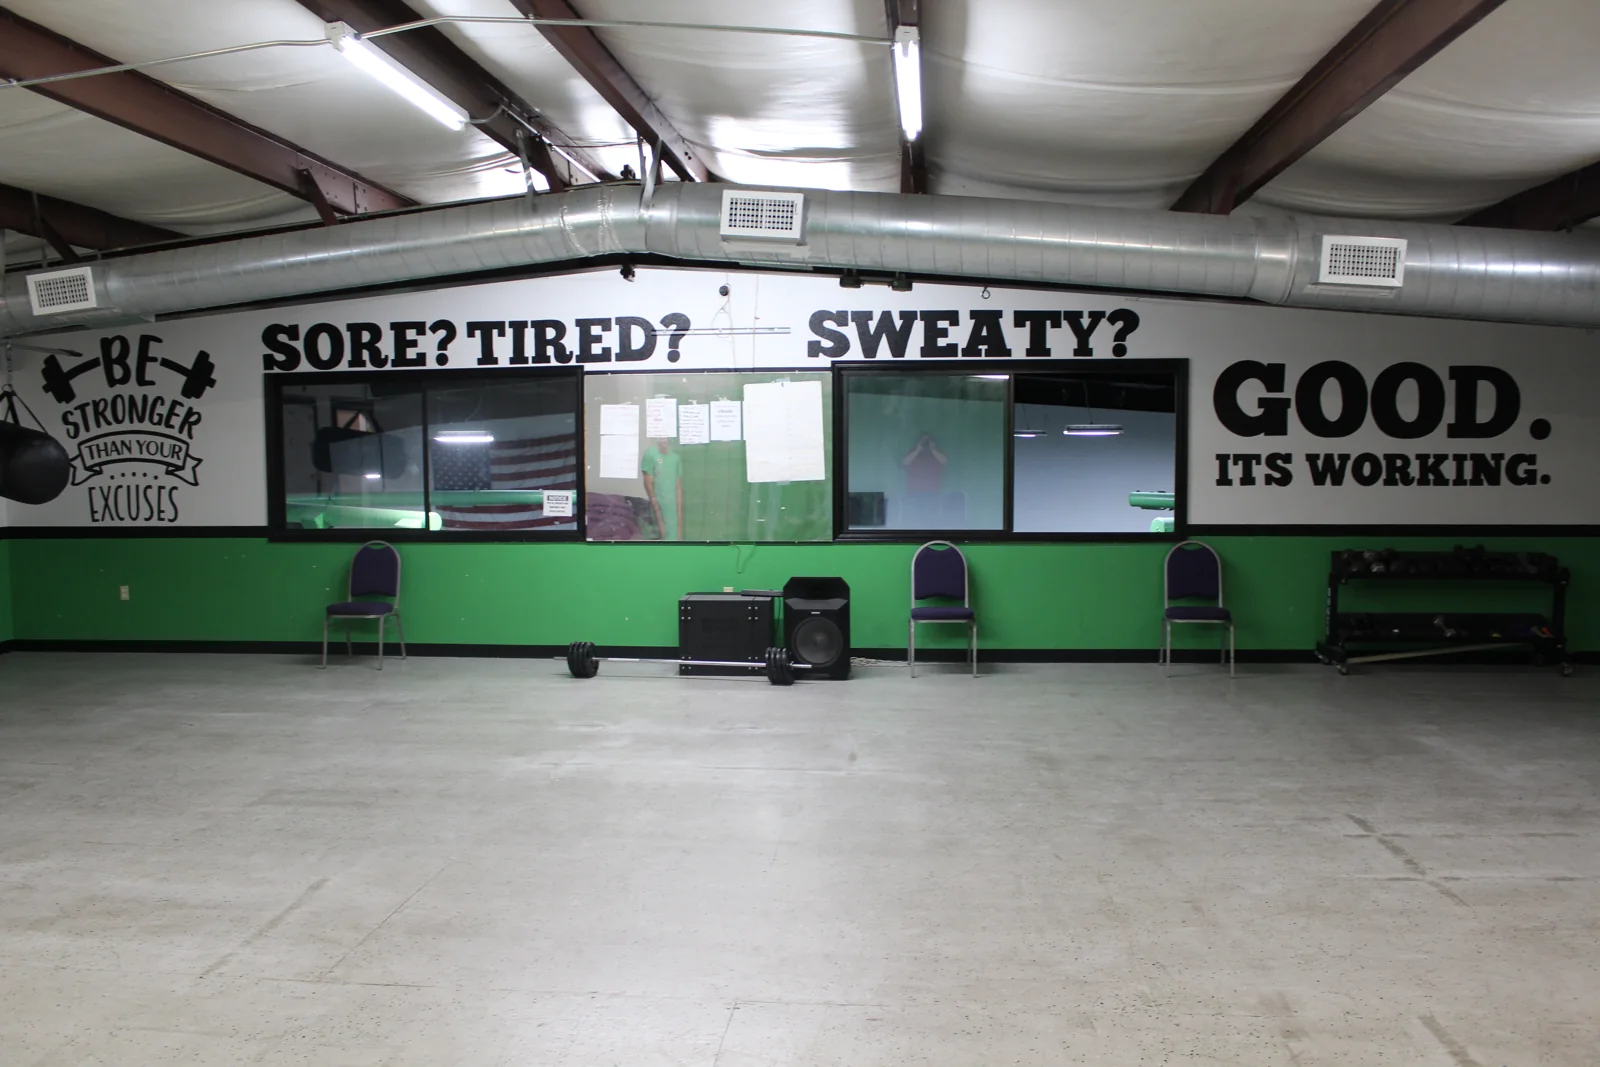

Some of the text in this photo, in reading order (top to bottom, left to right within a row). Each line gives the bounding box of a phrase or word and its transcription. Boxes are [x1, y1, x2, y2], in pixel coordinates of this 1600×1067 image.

[100, 334, 163, 388] BE
[261, 308, 1140, 371] SORE? TIRED? SWEATY?
[61, 393, 202, 440] STRONGER
[1213, 360, 1552, 440] GOOD.
[86, 440, 182, 461] THAN YOUR
[1215, 452, 1552, 487] ITS WORKING.
[88, 485, 179, 522] EXCUSES
